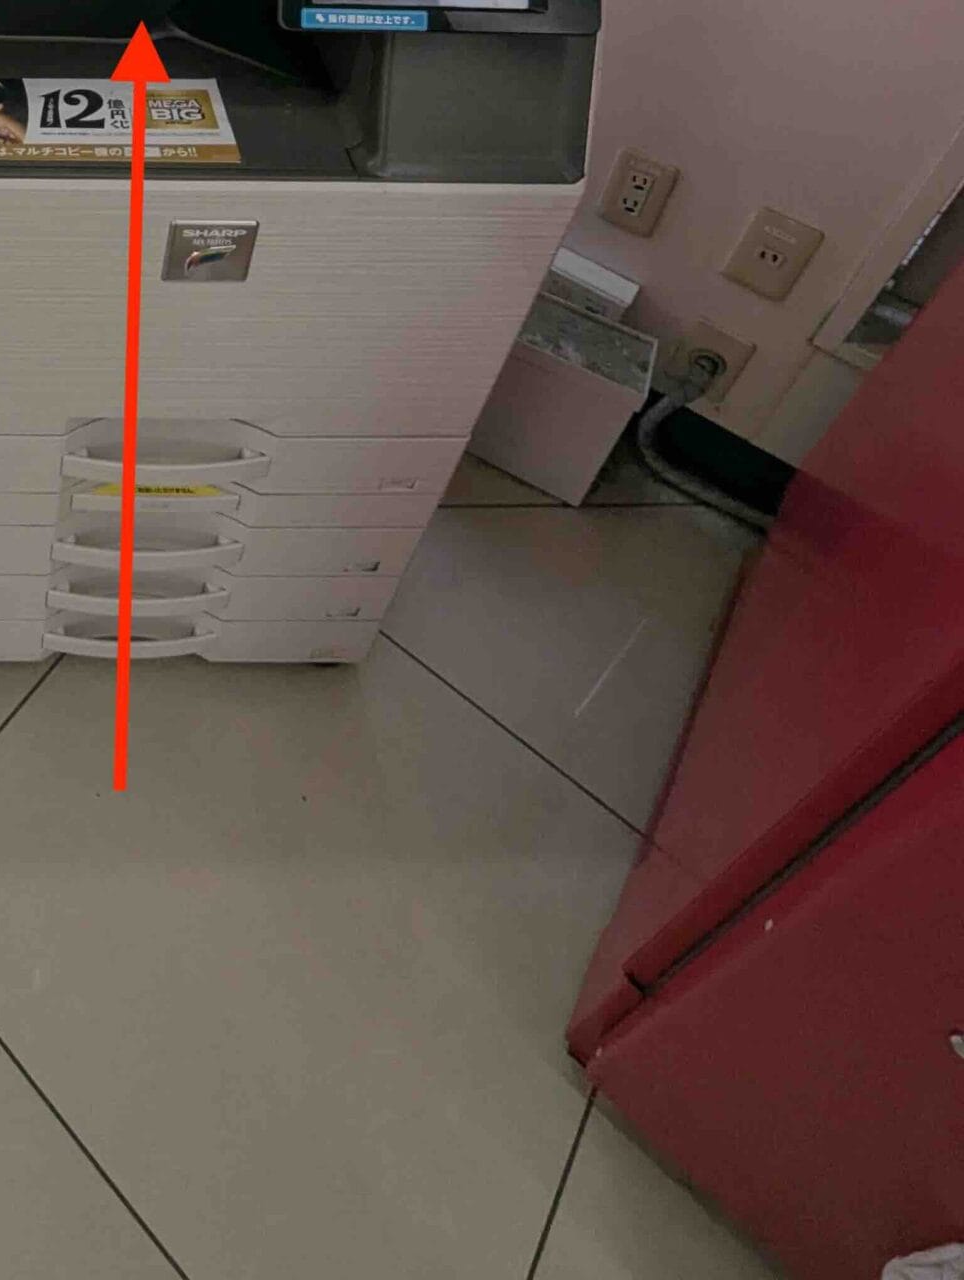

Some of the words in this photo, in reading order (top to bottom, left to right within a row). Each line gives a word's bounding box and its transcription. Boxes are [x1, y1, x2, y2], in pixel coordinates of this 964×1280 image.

[40, 89, 107, 129] 12
[148, 98, 202, 110] MEGA
[150, 108, 203, 121] BIG
[182, 228, 247, 238] SHARP
